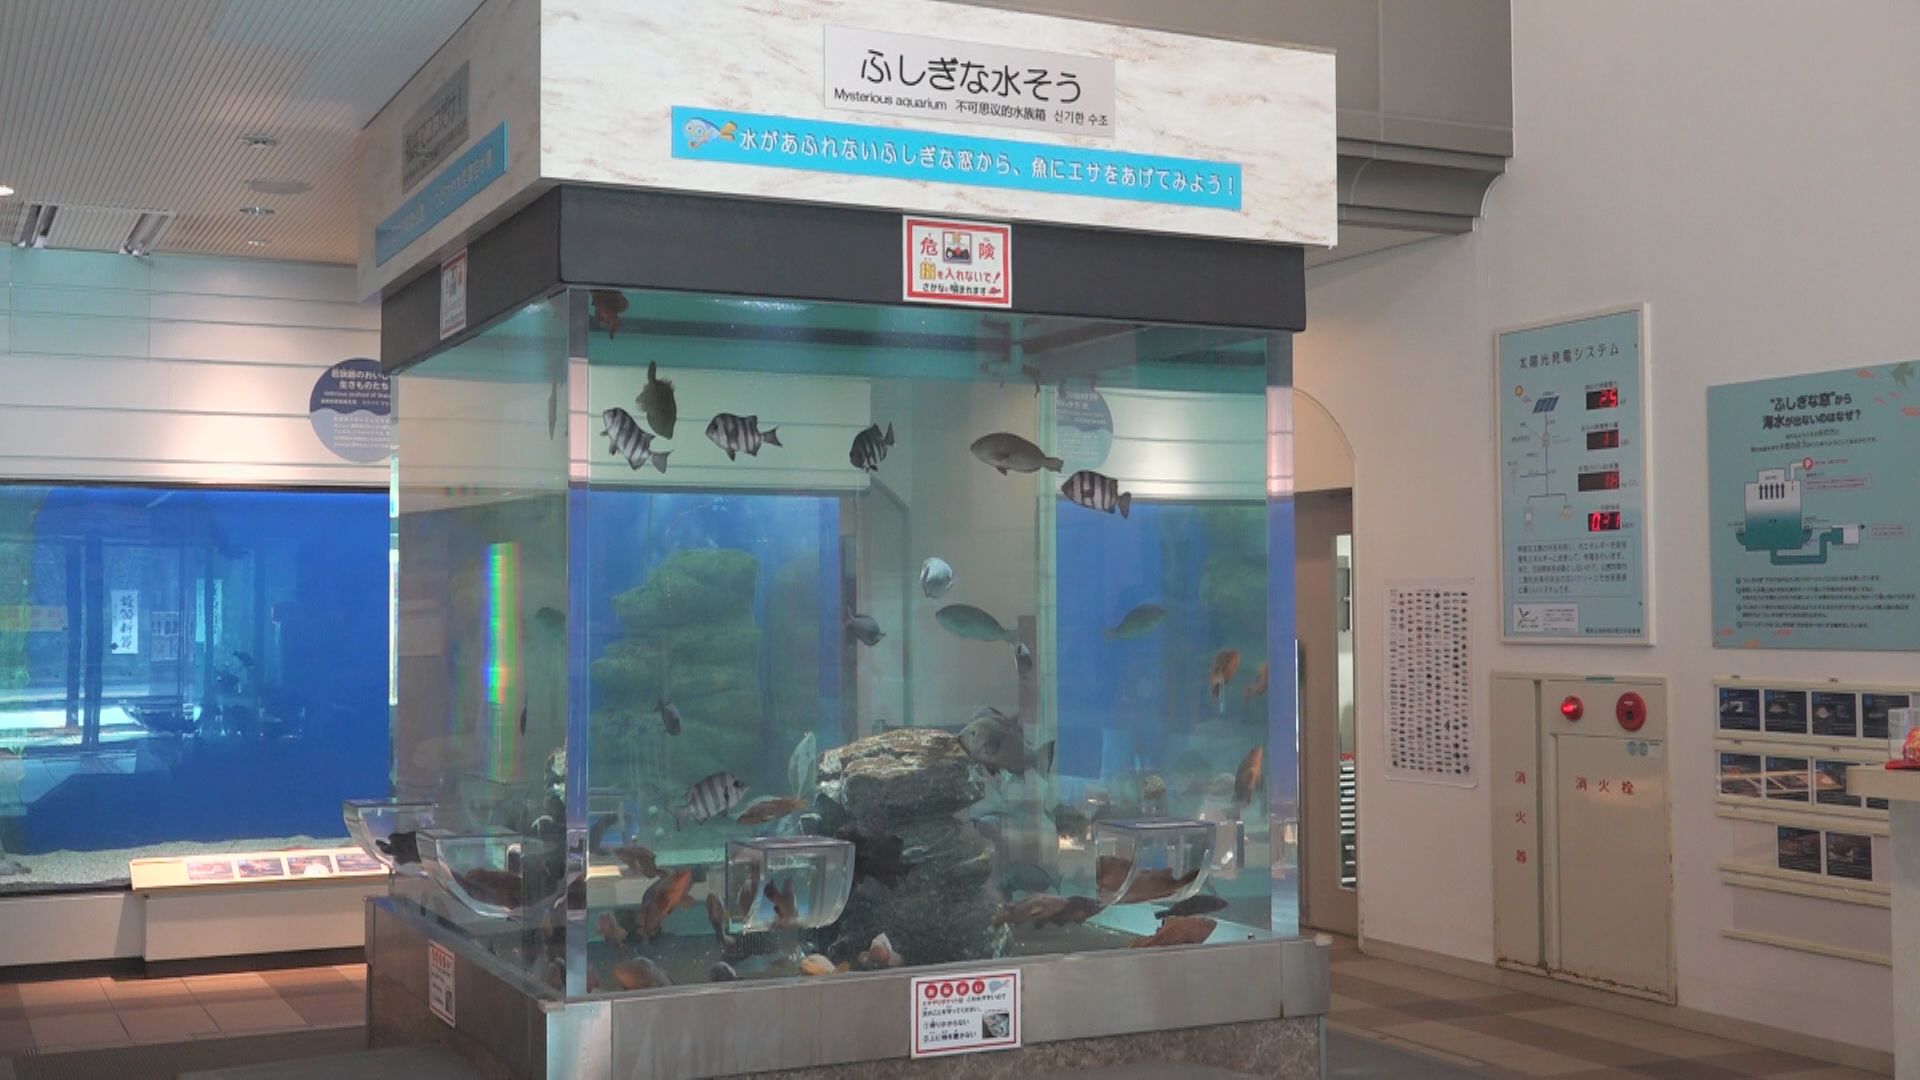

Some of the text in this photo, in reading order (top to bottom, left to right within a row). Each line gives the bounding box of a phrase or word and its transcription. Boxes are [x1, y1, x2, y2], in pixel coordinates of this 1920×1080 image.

[861, 49, 1081, 103] ふしぎな水そう
[834, 87, 948, 111] Mysterious aquarium
[955, 99, 1047, 122] 不可思议的水族箱
[1054, 109, 1109, 126] 신기한 수조
[739, 128, 1235, 196] 水があふれないふしぎな窓から、魚にエサをあげてみよう！
[1519, 343, 1619, 369] 太陽光発電システム
[1575, 775, 1634, 796] 消火栓
[1514, 770, 1527, 864] 消火器
